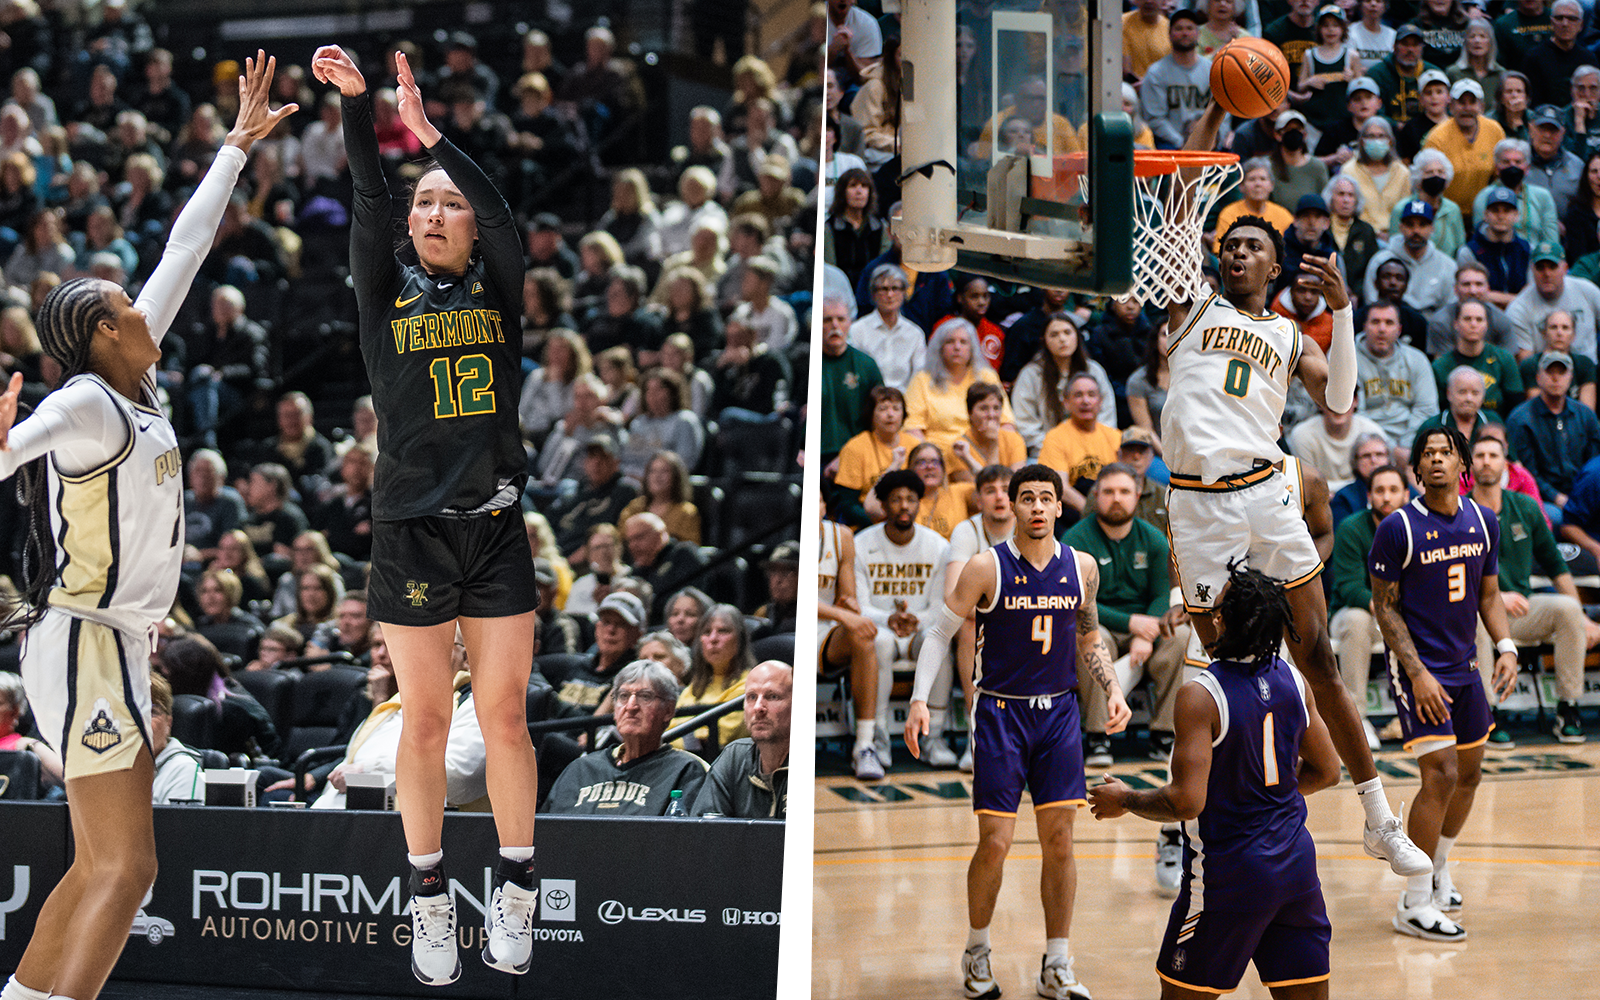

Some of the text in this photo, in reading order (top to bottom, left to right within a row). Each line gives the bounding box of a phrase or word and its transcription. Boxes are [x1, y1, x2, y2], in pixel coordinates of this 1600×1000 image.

[1247, 53, 1284, 105] THE ROCK
[1167, 84, 1213, 109] UVM
[391, 309, 506, 354] VERMONT
[1201, 326, 1282, 380] VERMONT
[429, 353, 497, 419] 12
[1223, 357, 1253, 400] 0
[1420, 542, 1484, 565] UALBANY
[868, 563, 933, 579] VERMONT
[1447, 562, 1467, 603] 3
[872, 580, 927, 596] ENERGY
[1004, 595, 1079, 610] UALBANY
[1031, 614, 1053, 656] 4
[82, 731, 121, 750] PURDUE
[1263, 711, 1280, 787] 1
[574, 780, 650, 807] PURDUE
[192, 866, 492, 919] ROHRMN
[201, 915, 378, 945] AUTOMOTIVE
[628, 907, 707, 923] LEXUS
[533, 928, 584, 942] TOYOTA
